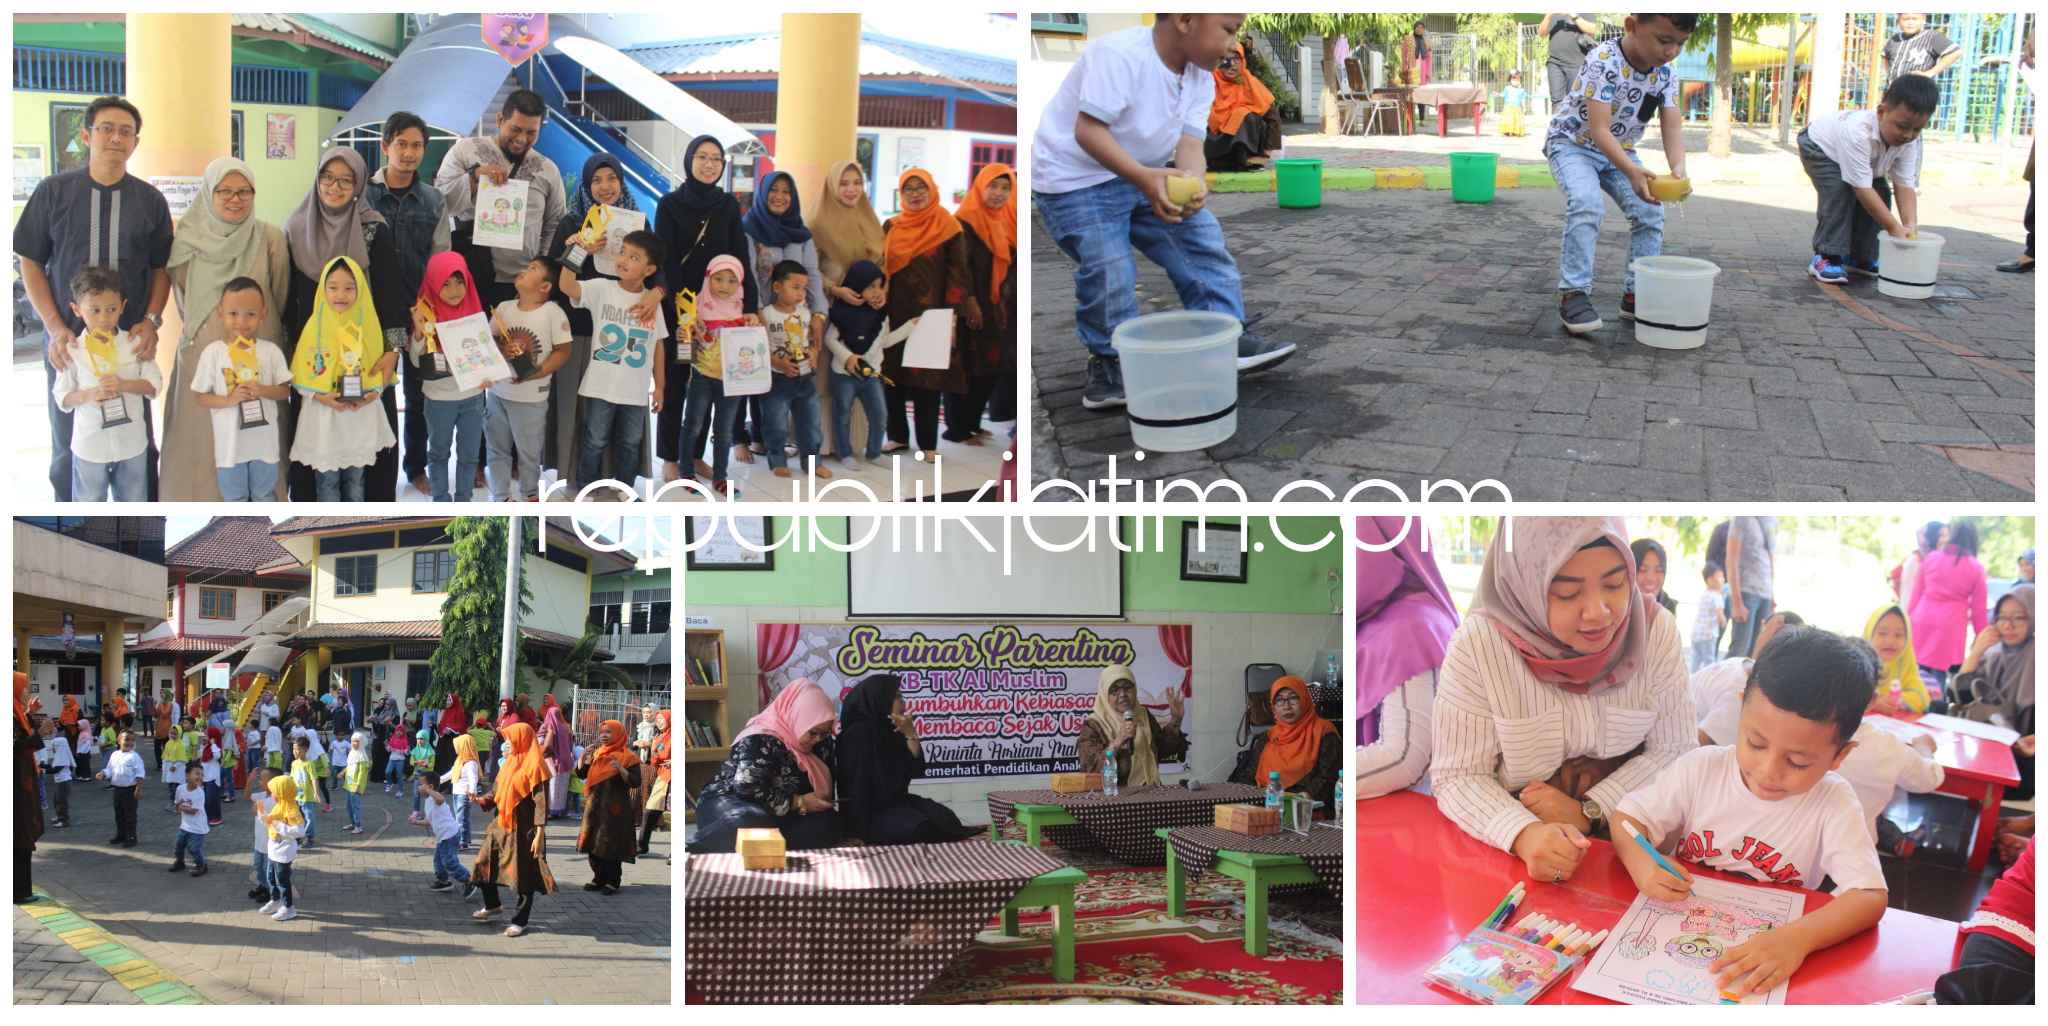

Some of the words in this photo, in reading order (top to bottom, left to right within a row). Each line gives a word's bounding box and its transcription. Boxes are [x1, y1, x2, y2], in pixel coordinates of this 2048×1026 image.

[178, 186, 191, 196] Finger
[593, 323, 650, 369] 25
[686, 617, 708, 625] Baca
[839, 628, 980, 673] Seminar
[982, 628, 1134, 667] Parenting
[892, 671, 958, 691] KB-TK
[963, 670, 986, 690] Al
[992, 669, 1064, 689] Muslim
[913, 715, 999, 736] Membaca
[1003, 713, 1058, 738] Sejak
[926, 741, 983, 763] Rininta
[924, 764, 981, 777] emerhati
[984, 762, 1050, 775] Pendidikan
[1053, 760, 1081, 773] Anak
[1675, 830, 1722, 860] COOL
